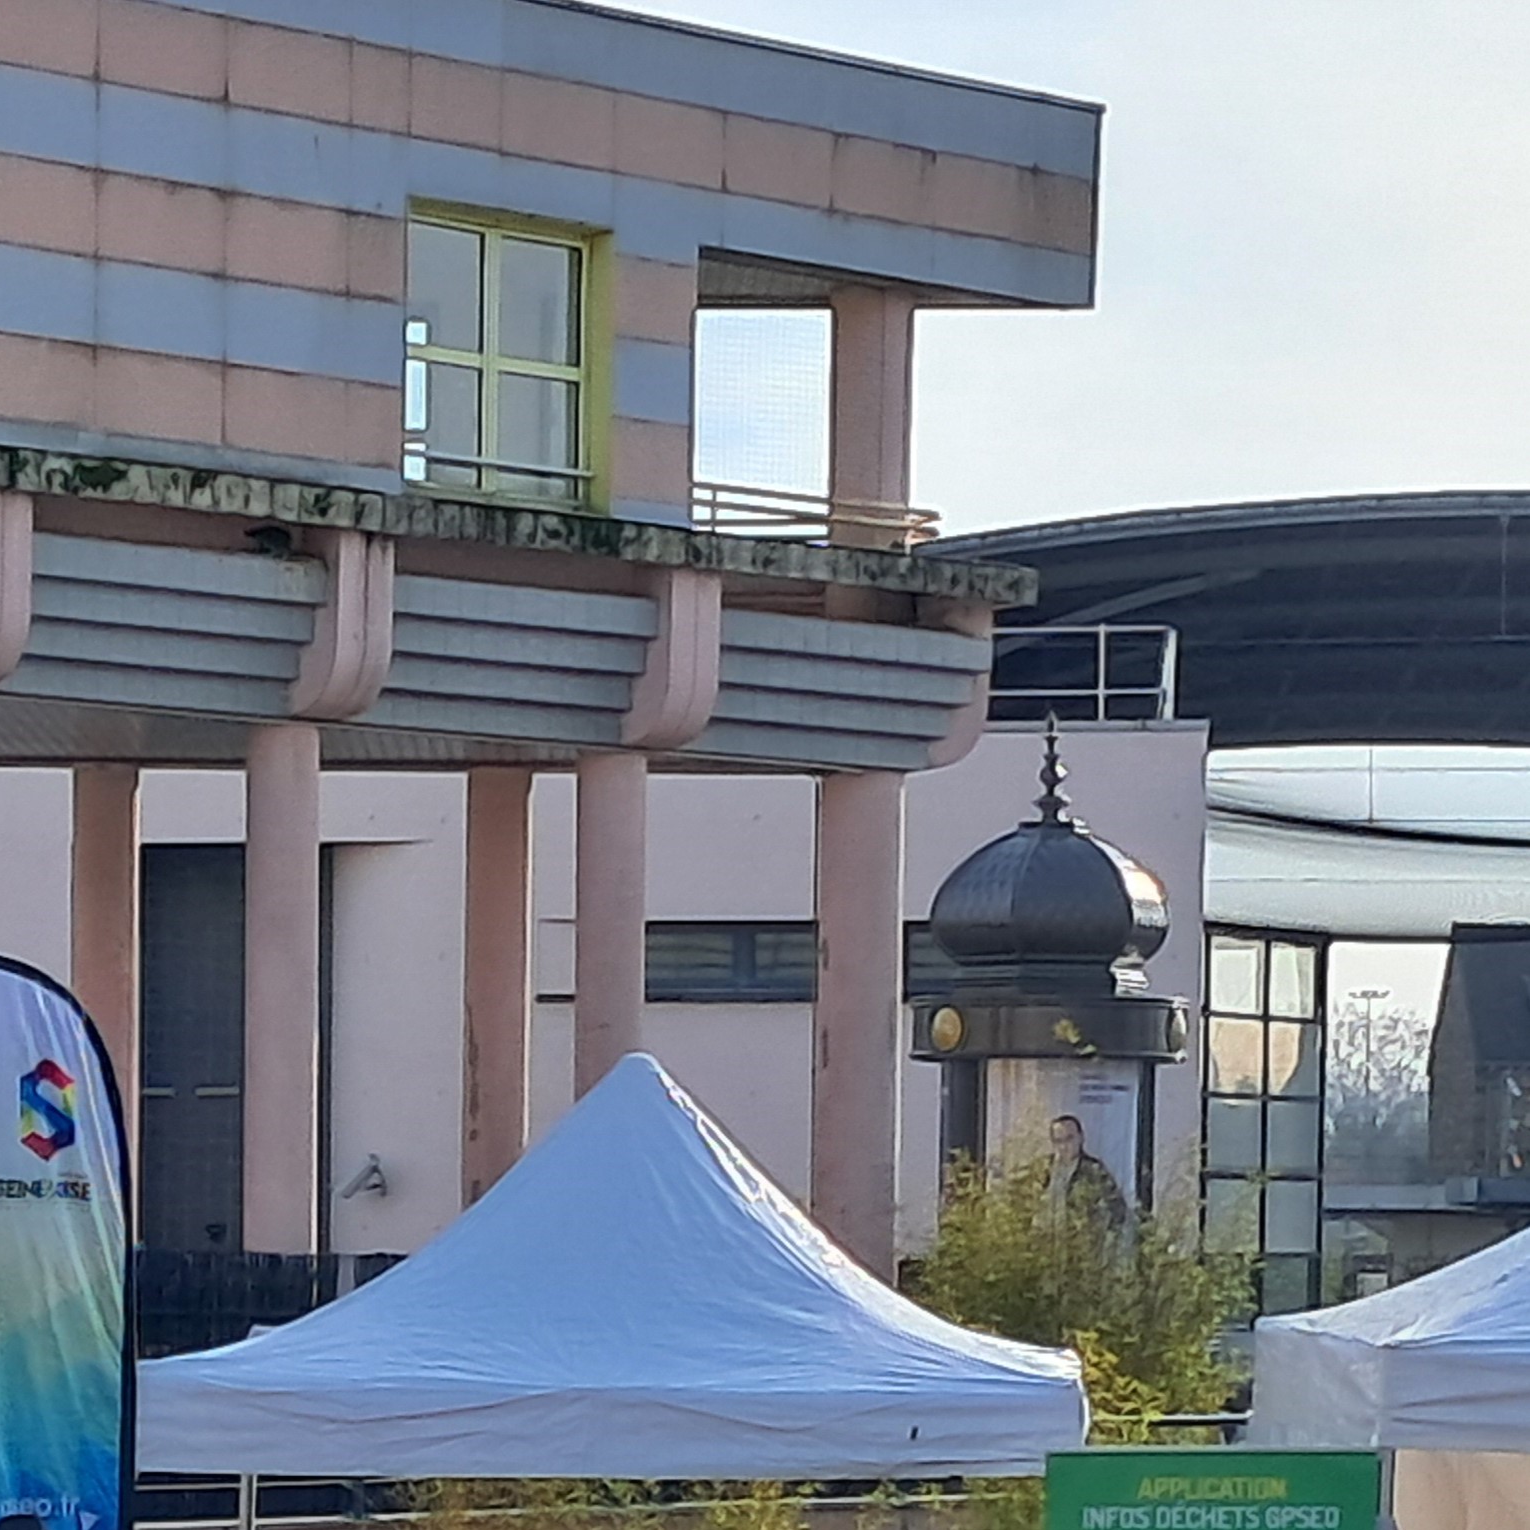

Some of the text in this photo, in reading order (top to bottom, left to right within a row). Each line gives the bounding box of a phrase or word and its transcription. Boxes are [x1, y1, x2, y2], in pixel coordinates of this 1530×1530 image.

[1137, 1477, 1287, 1500] APPLICATION
[1082, 1500, 1340, 1530] INFOS DÉCHETS GPSEO
